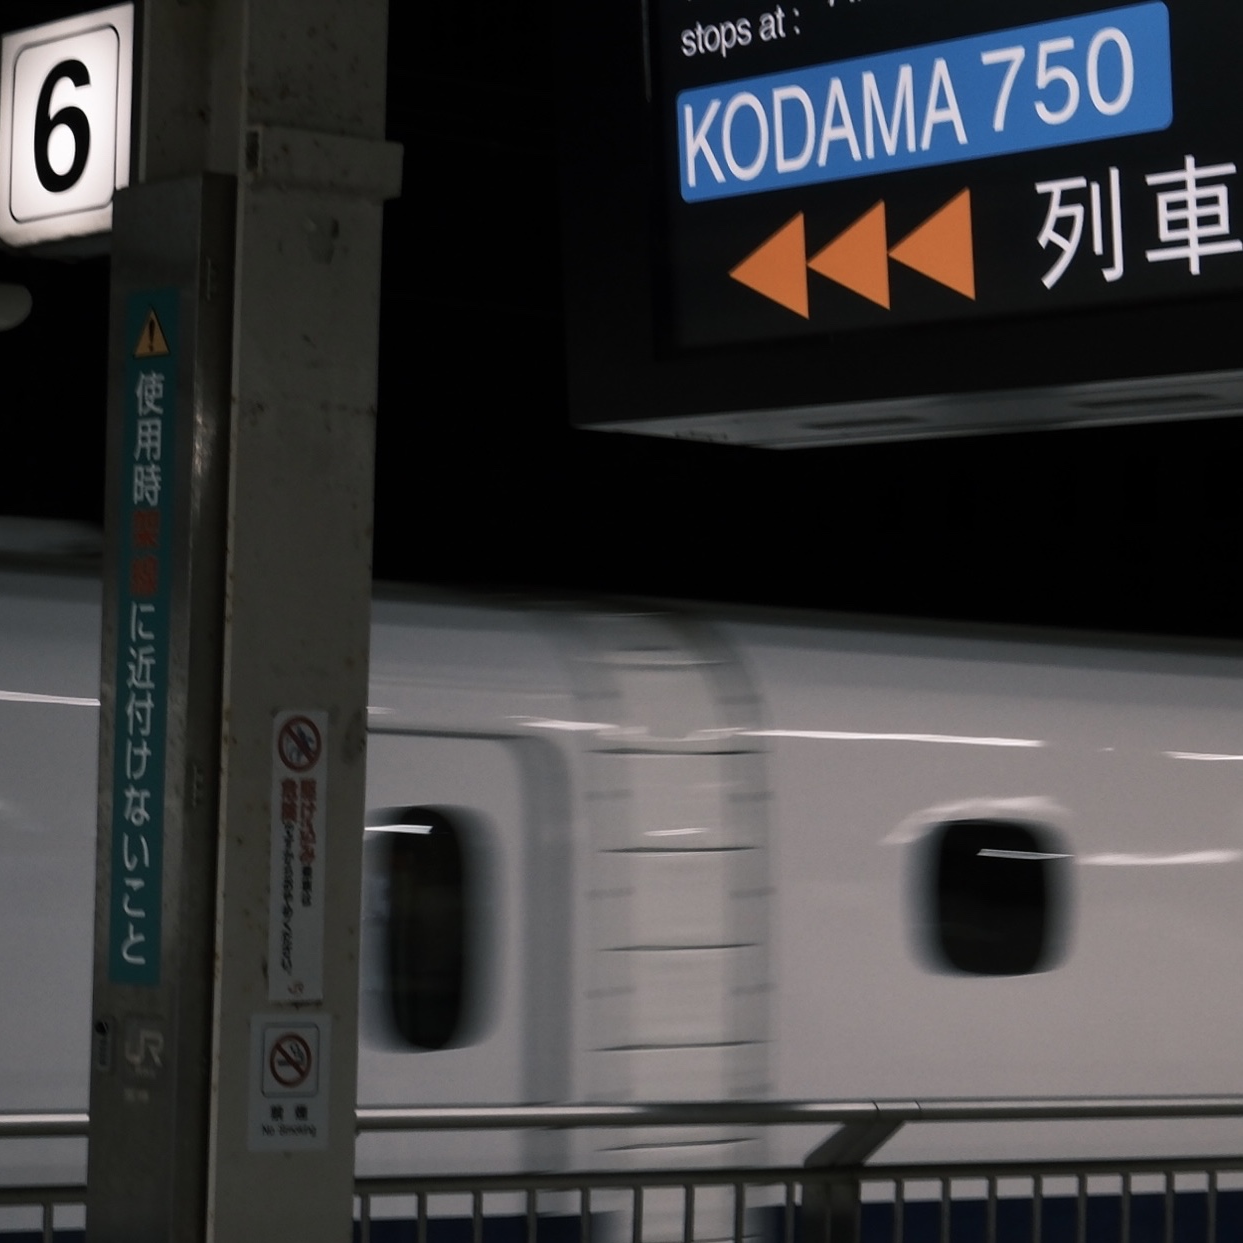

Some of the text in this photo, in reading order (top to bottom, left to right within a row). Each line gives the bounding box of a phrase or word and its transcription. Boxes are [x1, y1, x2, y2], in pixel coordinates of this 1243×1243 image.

[680, 18, 753, 59] stops
[34, 59, 91, 192] 6
[683, 26, 1135, 188] KODAMA 750
[1034, 154, 1243, 291] 列車
